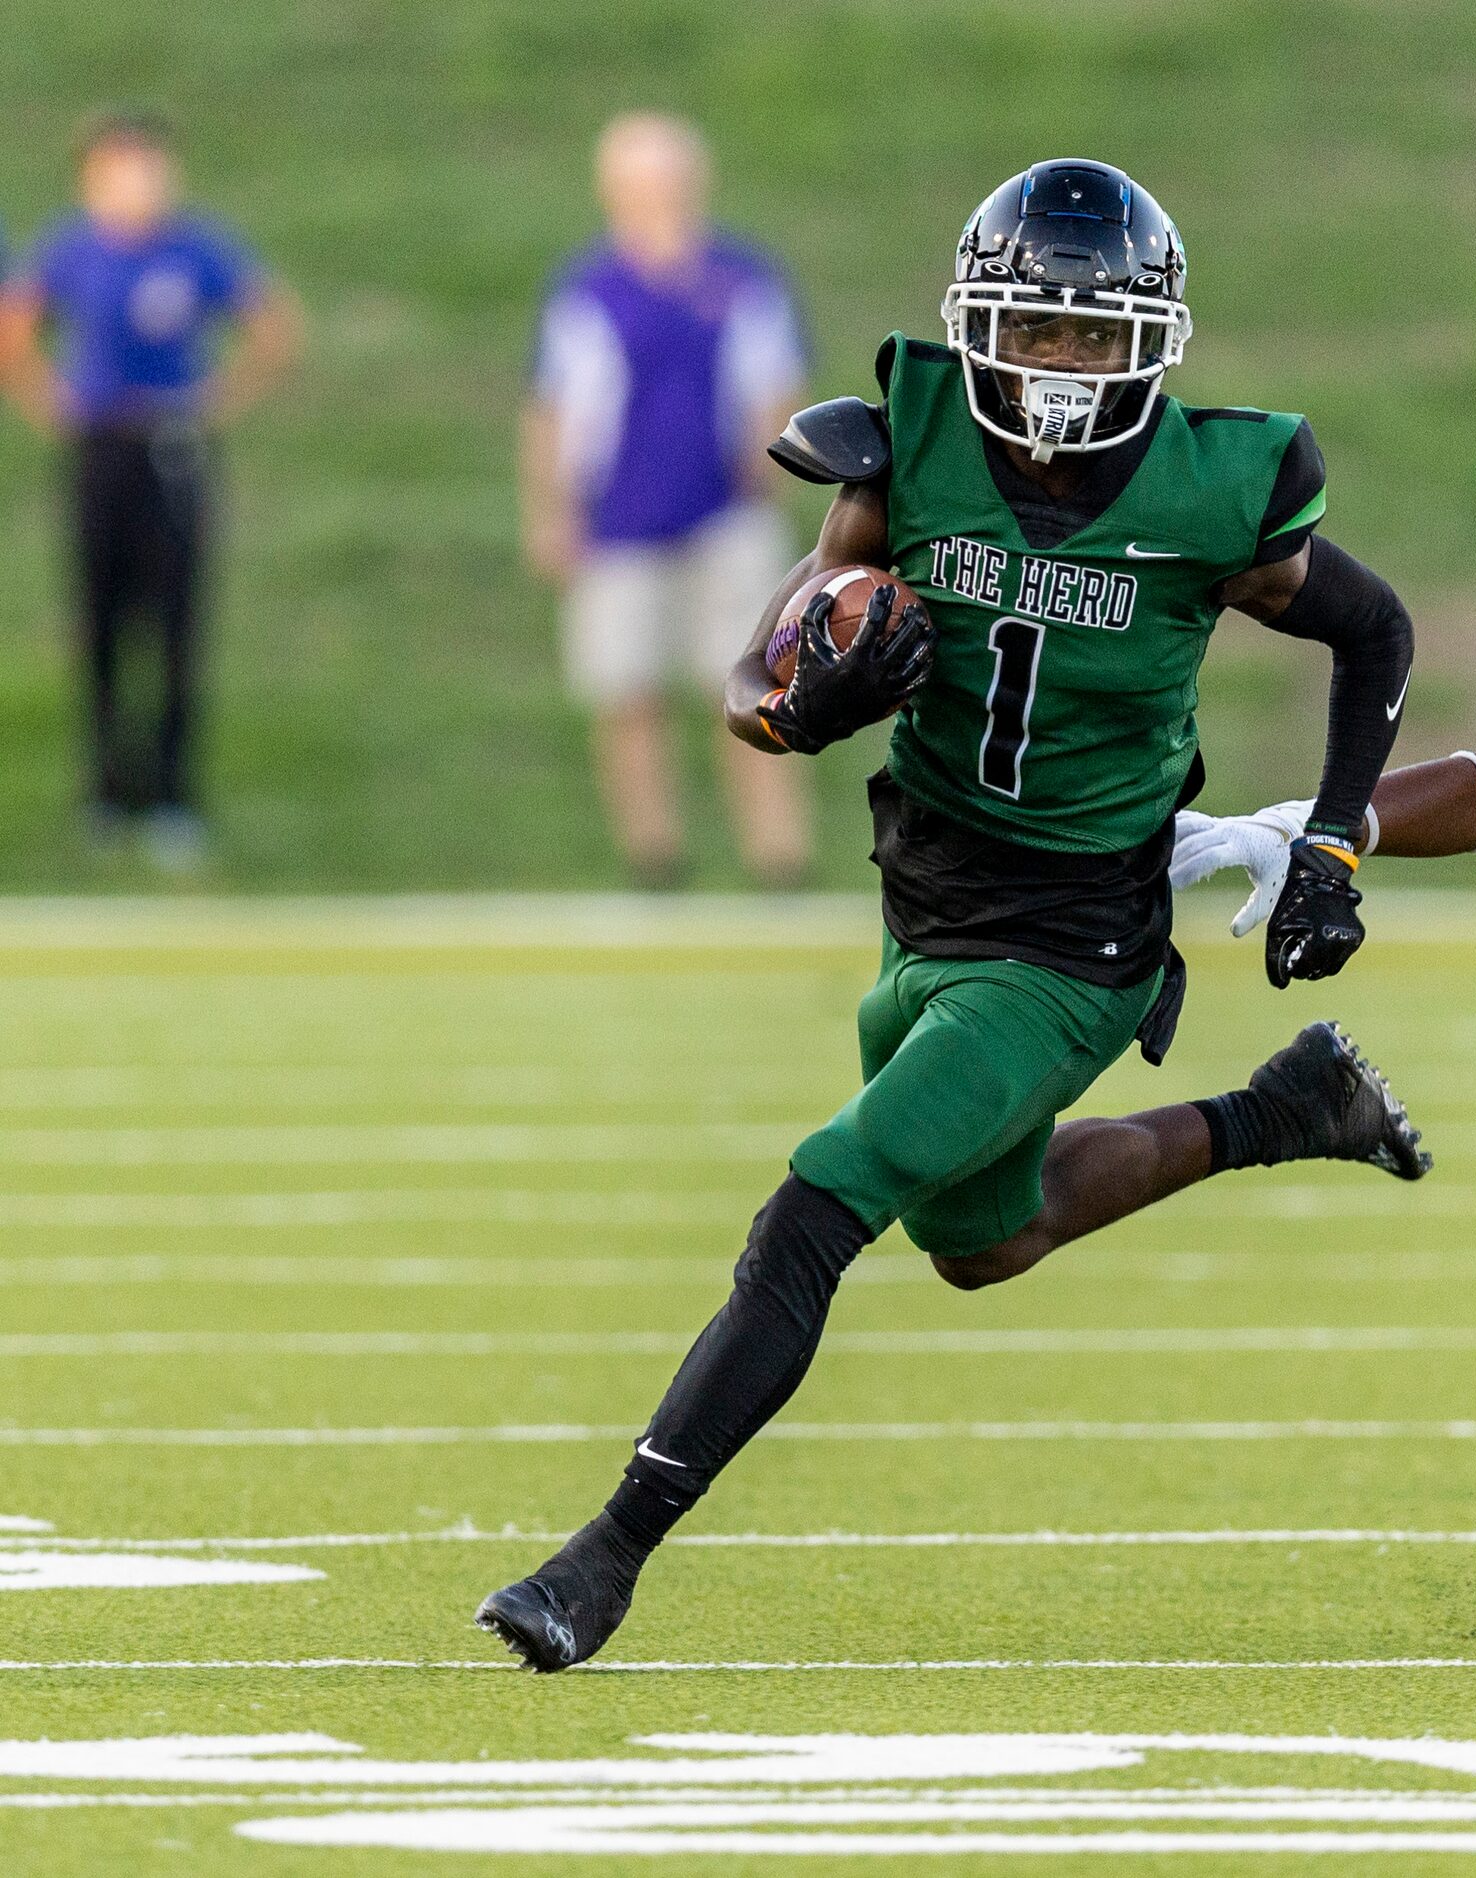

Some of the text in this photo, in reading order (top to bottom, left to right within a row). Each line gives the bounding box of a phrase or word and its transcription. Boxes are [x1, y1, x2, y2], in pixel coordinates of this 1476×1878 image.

[929, 535, 1138, 631] THE HERD
[978, 616, 1046, 801] 1
